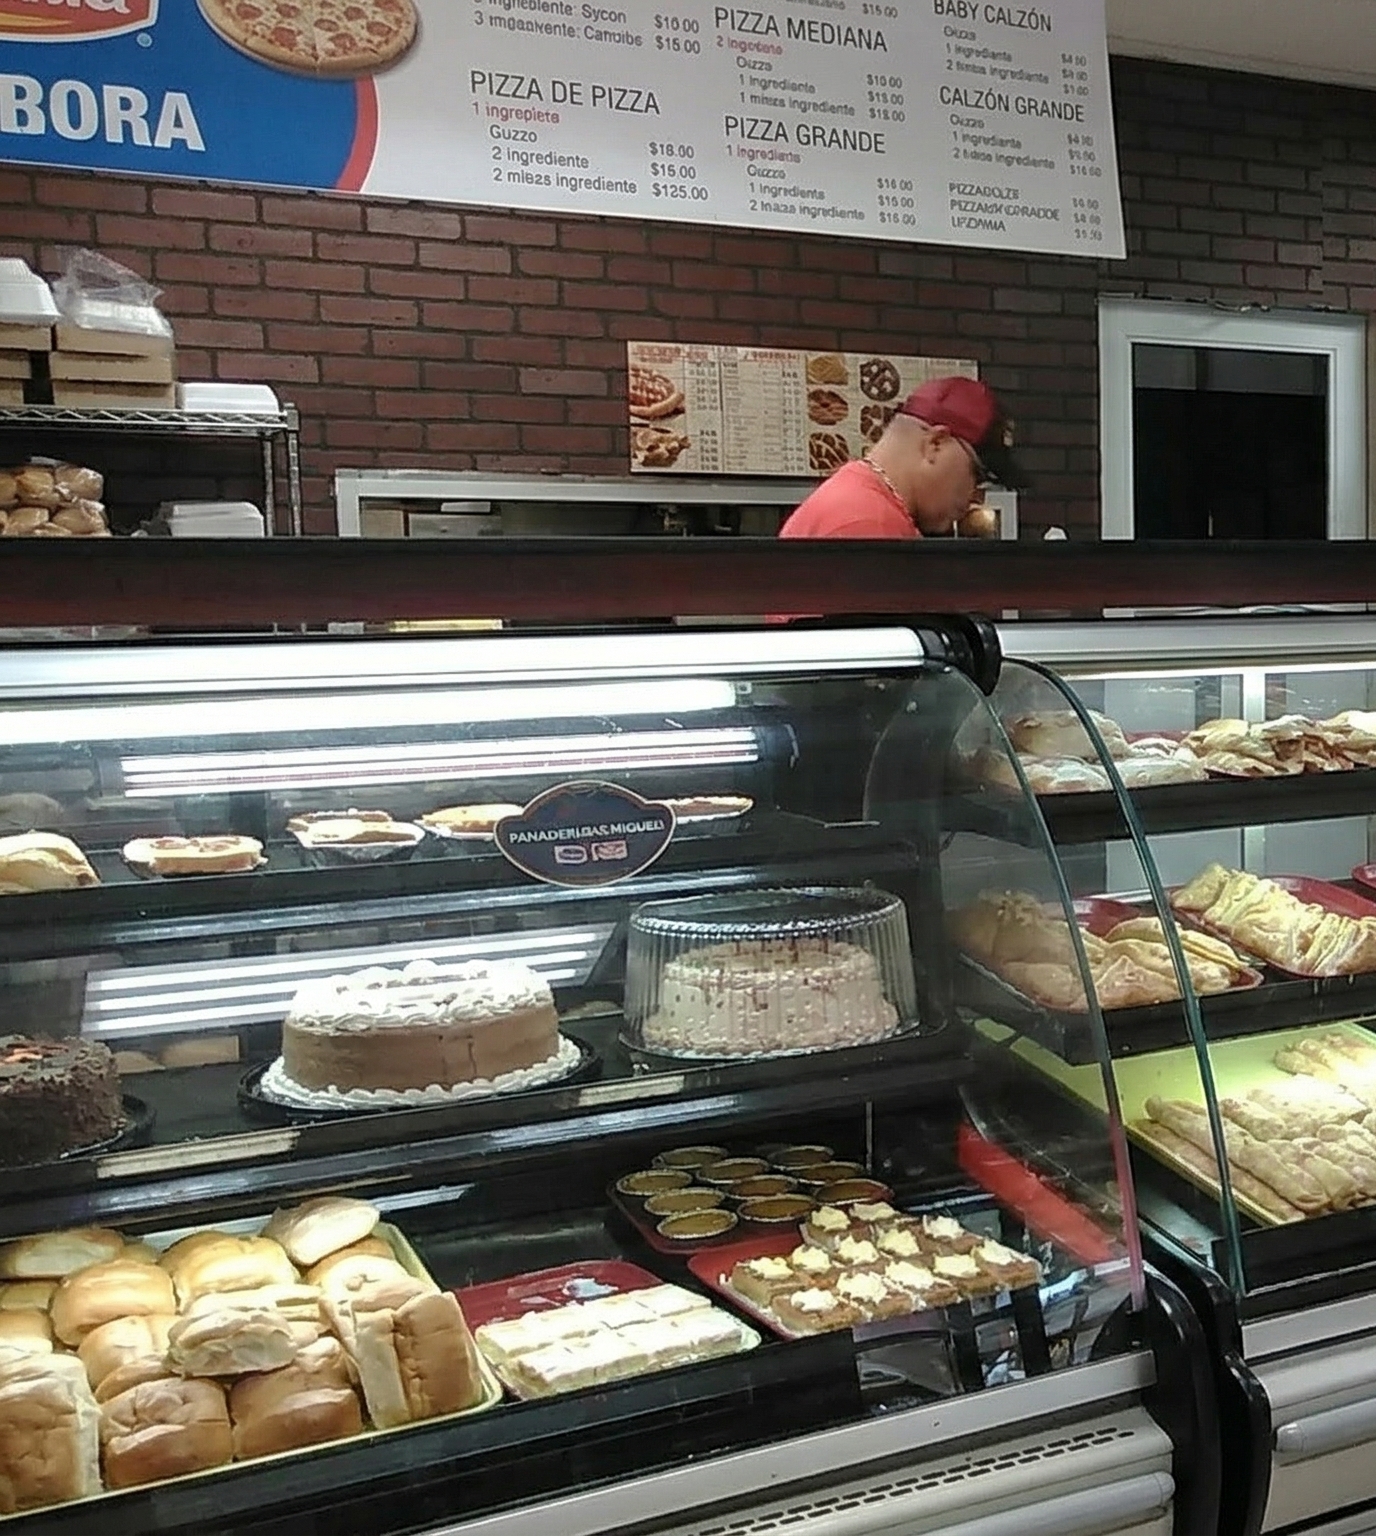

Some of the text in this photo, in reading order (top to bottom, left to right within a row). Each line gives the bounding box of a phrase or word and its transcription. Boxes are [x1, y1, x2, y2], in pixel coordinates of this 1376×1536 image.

[474, 10, 484, 26] 3
[715, 7, 780, 37] PIZZA
[787, 17, 887, 52] MEDIANA
[934, 0, 1051, 32] BABY CALZÓN
[471, 70, 660, 115] PIZZA DE PIZZA
[940, 86, 1085, 122] CALZÓN GRANDE
[489, 124, 538, 143] Guzzo
[725, 116, 886, 154] PIZZA GRANDE
[491, 146, 502, 161] 2
[507, 147, 589, 169] ingrediente
[493, 167, 503, 182] 2
[556, 172, 637, 194] ingrediente
[652, 182, 708, 201] $125.00
